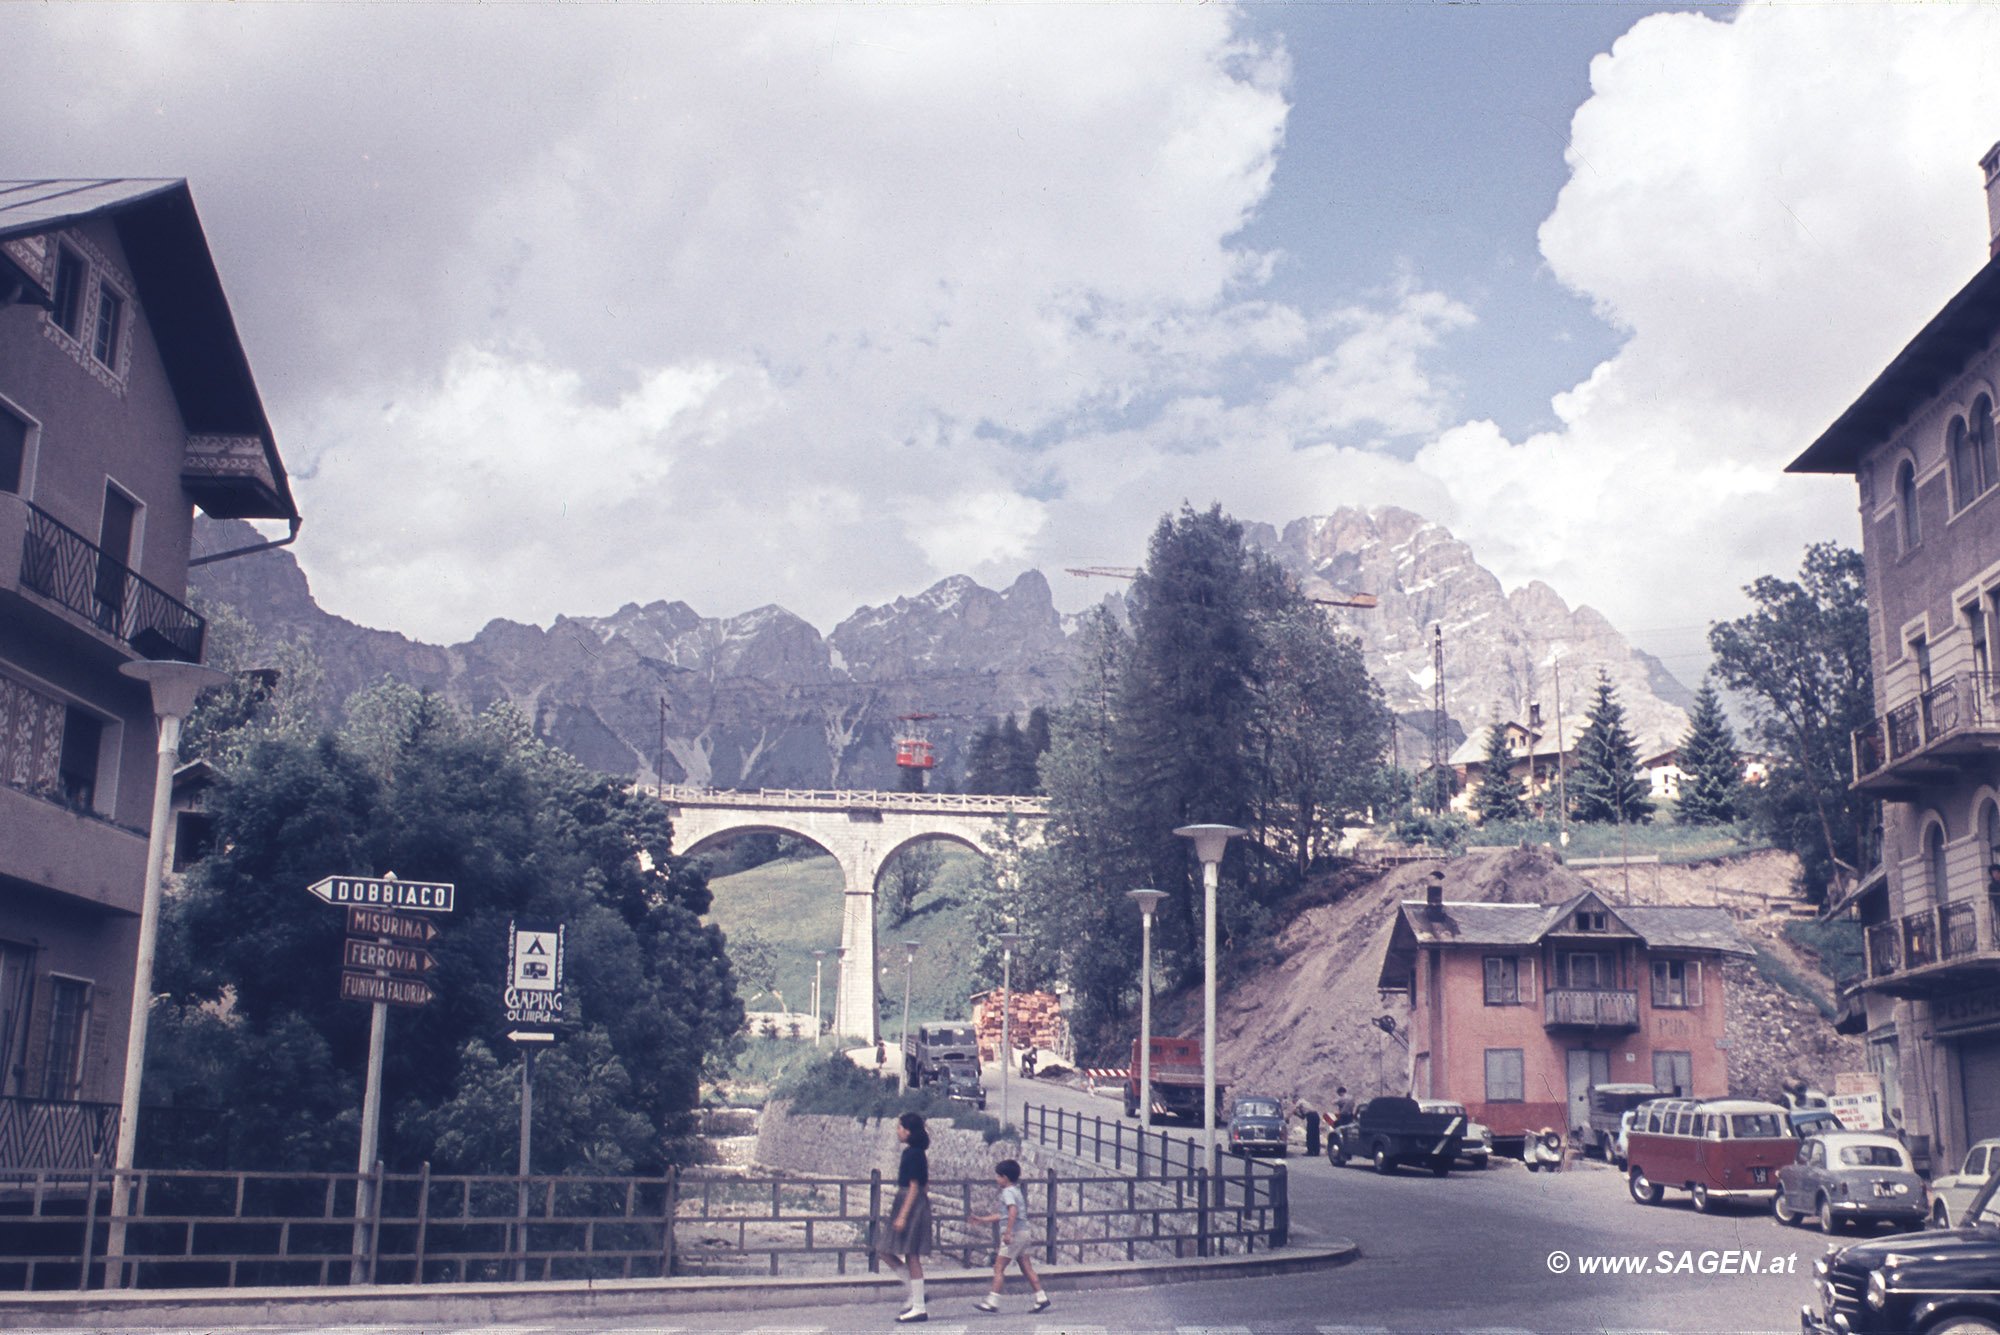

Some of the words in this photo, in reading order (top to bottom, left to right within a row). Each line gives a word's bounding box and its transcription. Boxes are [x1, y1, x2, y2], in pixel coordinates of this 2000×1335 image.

[338, 881, 445, 906] DOBBIACO
[354, 911, 423, 939] MISURINA
[352, 944, 418, 971] FERROVIA
[344, 976, 385, 999] FUNIVIA
[387, 981, 426, 1004] FALORIA
[504, 986, 563, 1011] CAMPING
